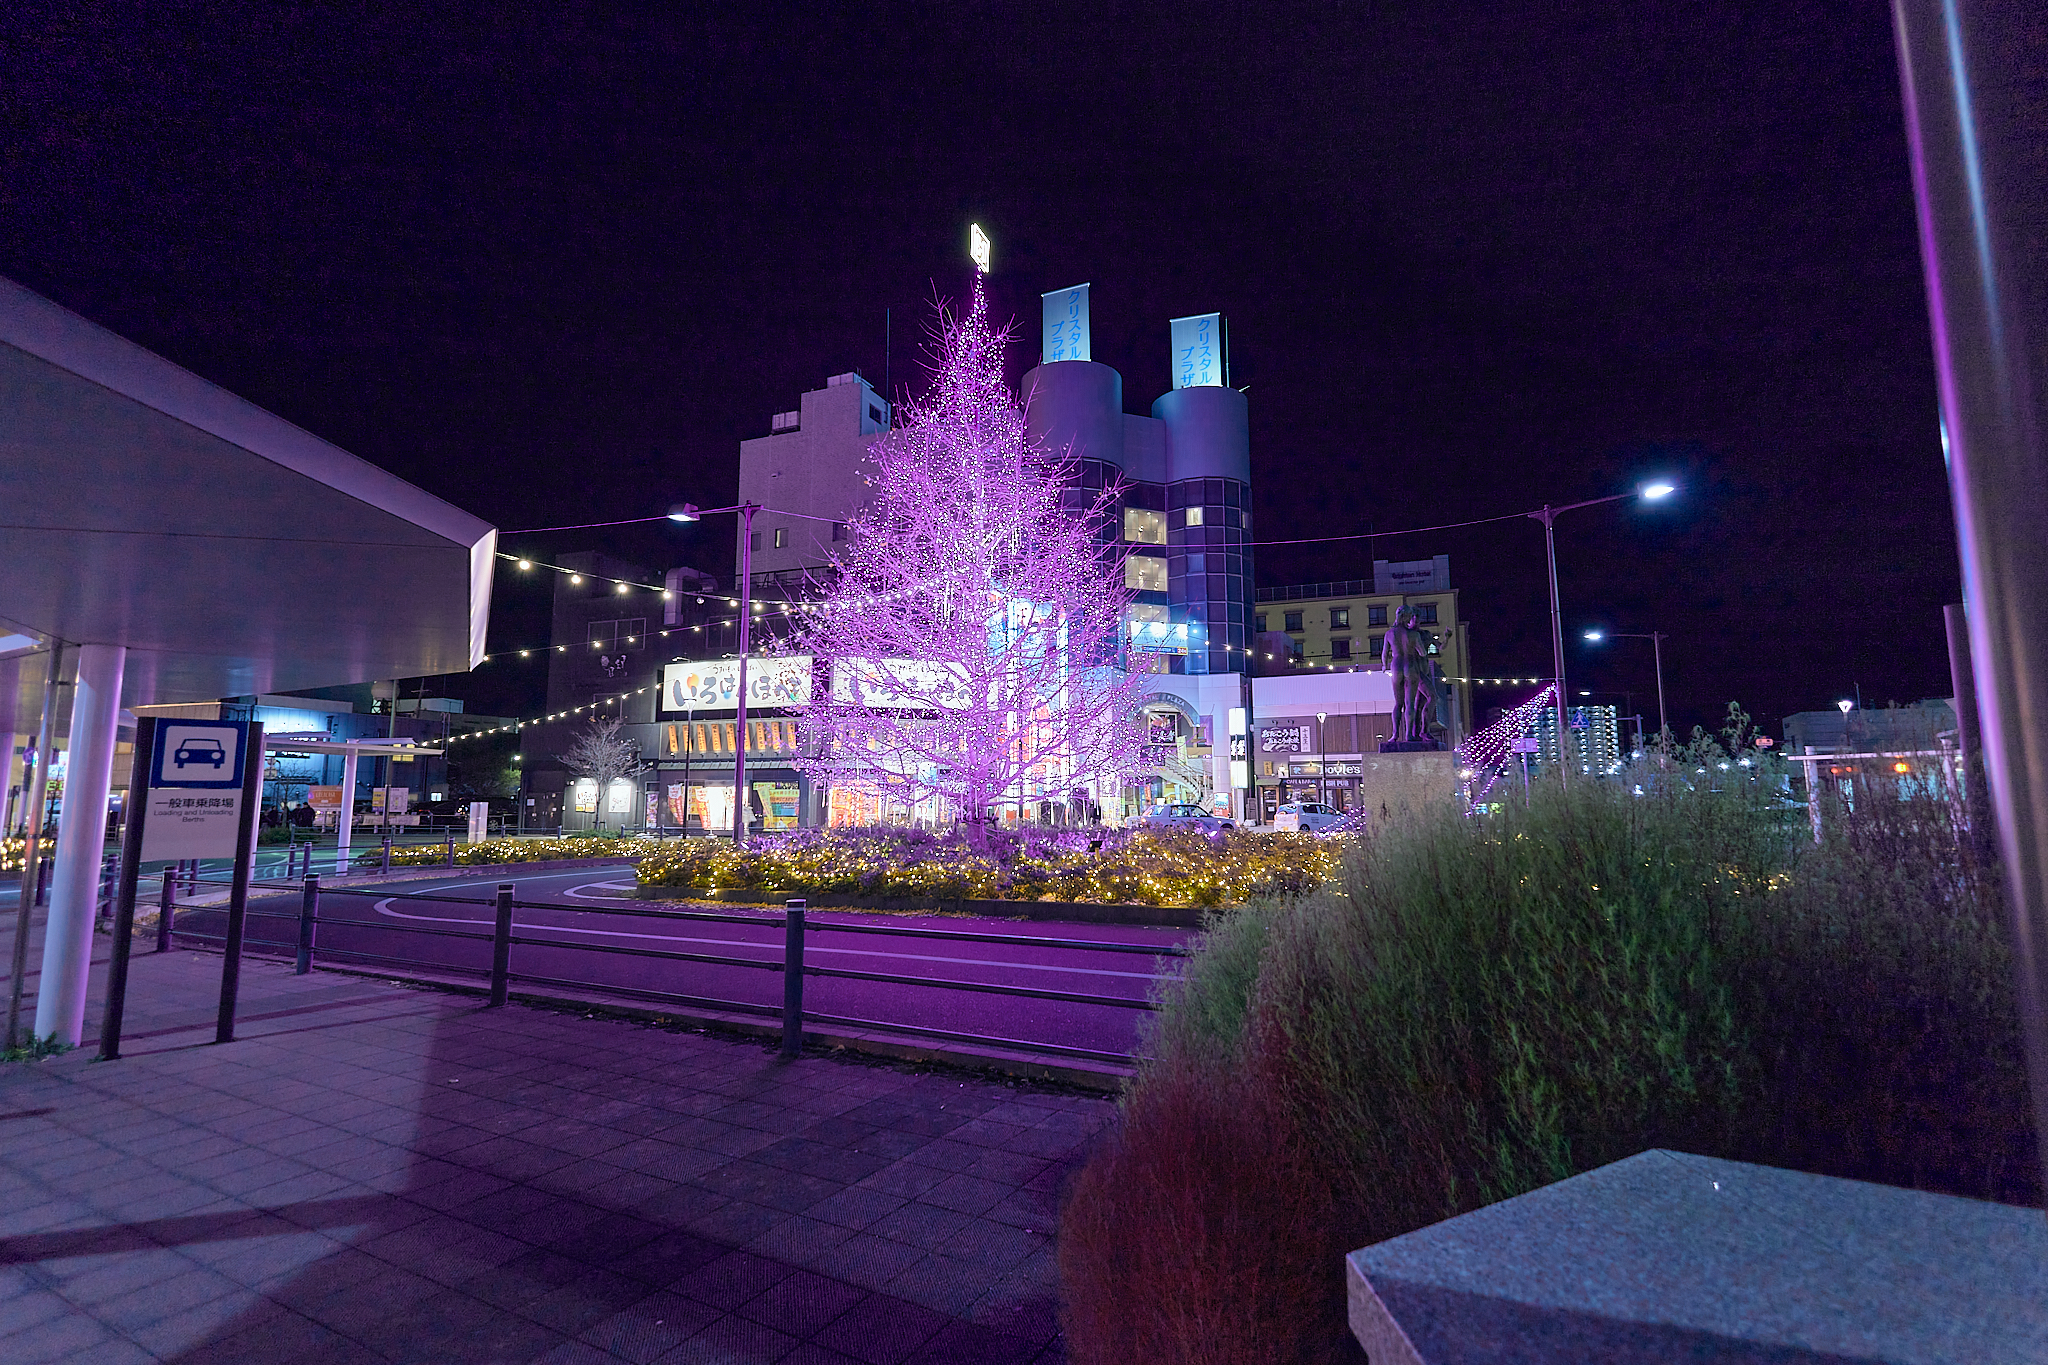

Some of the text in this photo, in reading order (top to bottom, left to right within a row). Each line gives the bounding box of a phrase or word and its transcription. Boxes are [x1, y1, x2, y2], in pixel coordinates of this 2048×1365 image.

[1050, 320, 1066, 361] プラザ
[1068, 290, 1082, 361] クリスタル
[1180, 345, 1196, 387] プラザ
[1197, 318, 1213, 385] クリスタル
[672, 673, 803, 707] いろはほへと
[1166, 694, 1186, 707] PLAZA
[1336, 779, 1349, 787] PUB
[153, 809, 183, 817] Loading
[199, 809, 234, 817] Unloading
[155, 797, 234, 809] 一般車乗降場
